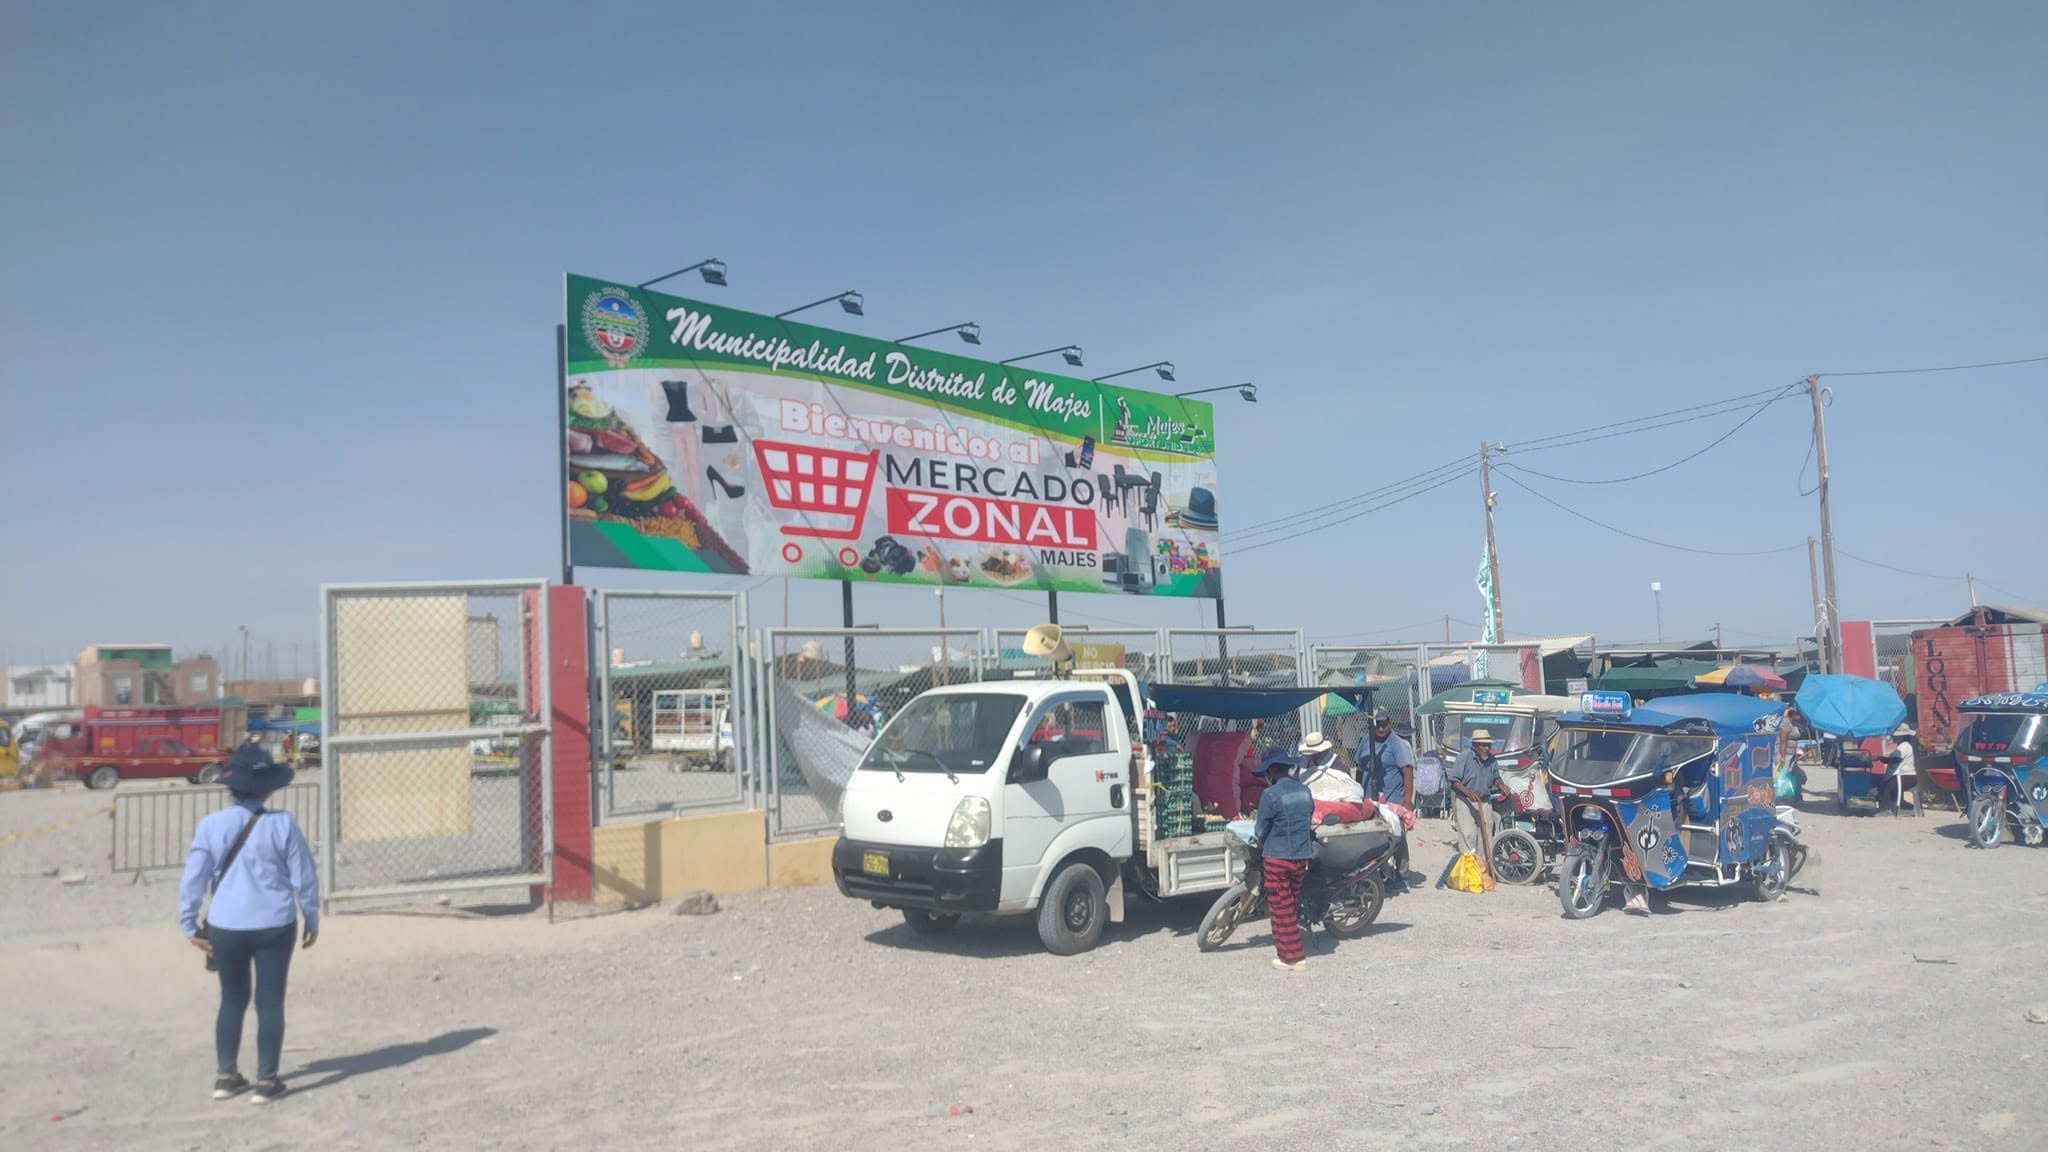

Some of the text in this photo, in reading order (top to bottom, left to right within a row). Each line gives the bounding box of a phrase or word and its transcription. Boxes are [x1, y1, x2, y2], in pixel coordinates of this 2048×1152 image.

[666, 306, 877, 380] Municipalidad
[884, 351, 985, 400] Distrital
[991, 379, 1017, 406] de
[1024, 377, 1092, 422] Majes
[780, 398, 1040, 465] Bienvenidos al
[886, 454, 1095, 505] MERCADO
[907, 495, 1089, 545] ZONAL
[1041, 549, 1097, 568] MAJES
[1083, 646, 1098, 659] NO
